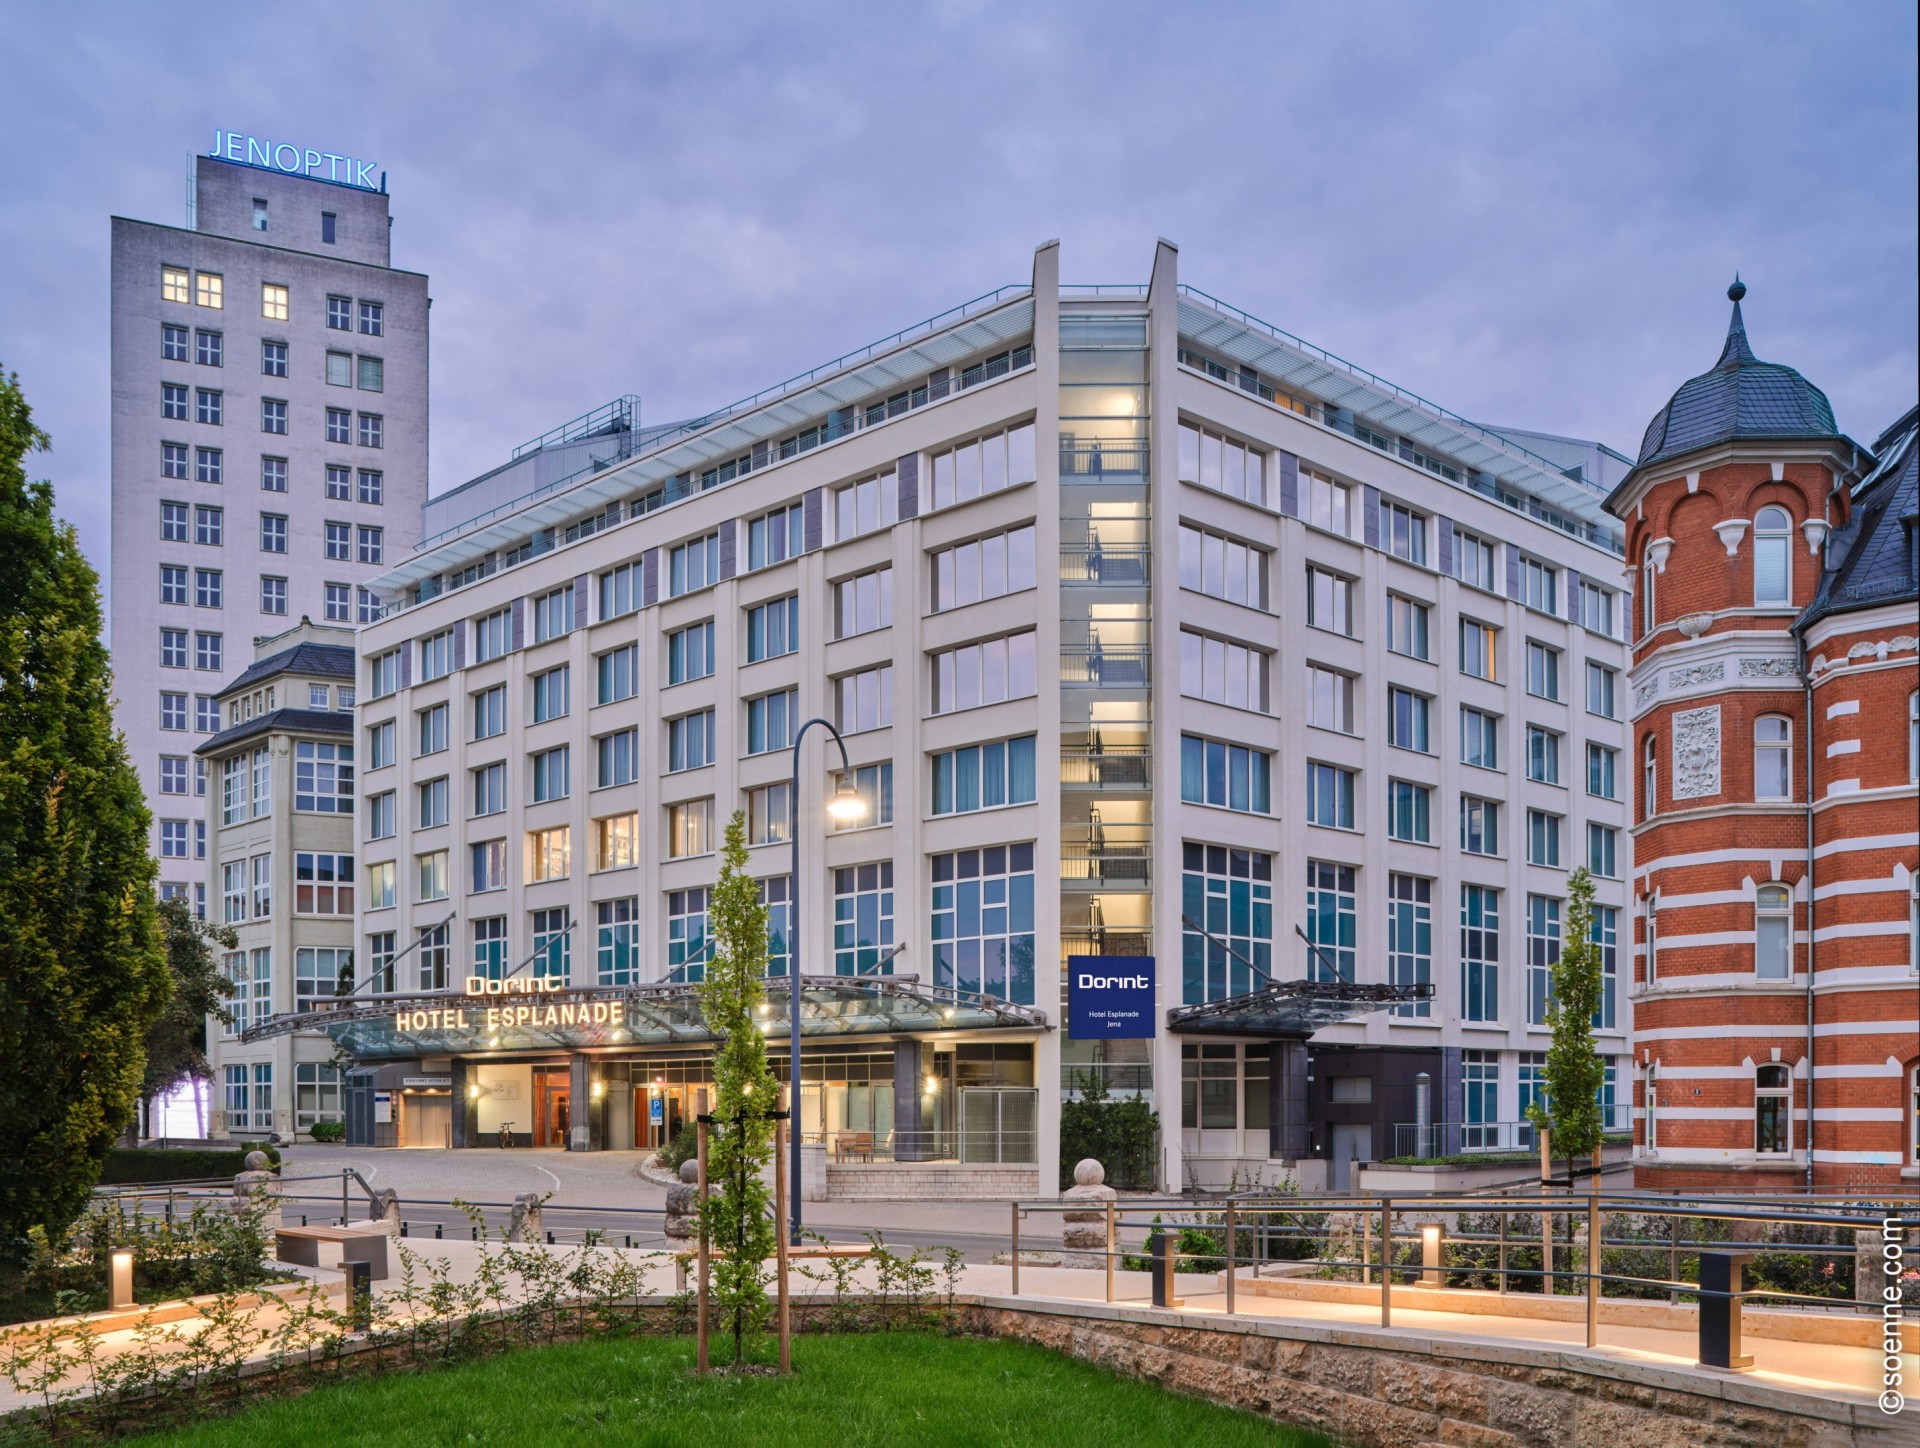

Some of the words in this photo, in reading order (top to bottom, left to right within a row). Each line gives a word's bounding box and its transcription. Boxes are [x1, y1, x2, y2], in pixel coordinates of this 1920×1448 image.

[209, 129, 377, 190] JENOPTIK
[465, 973, 563, 996] Dorint
[1078, 974, 1149, 989] Dorint
[396, 1009, 469, 1032] HOTEL
[487, 1001, 623, 1028] ESPLANADE
[1107, 1010, 1139, 1018] Esplanade
[653, 1100, 660, 1110] P
